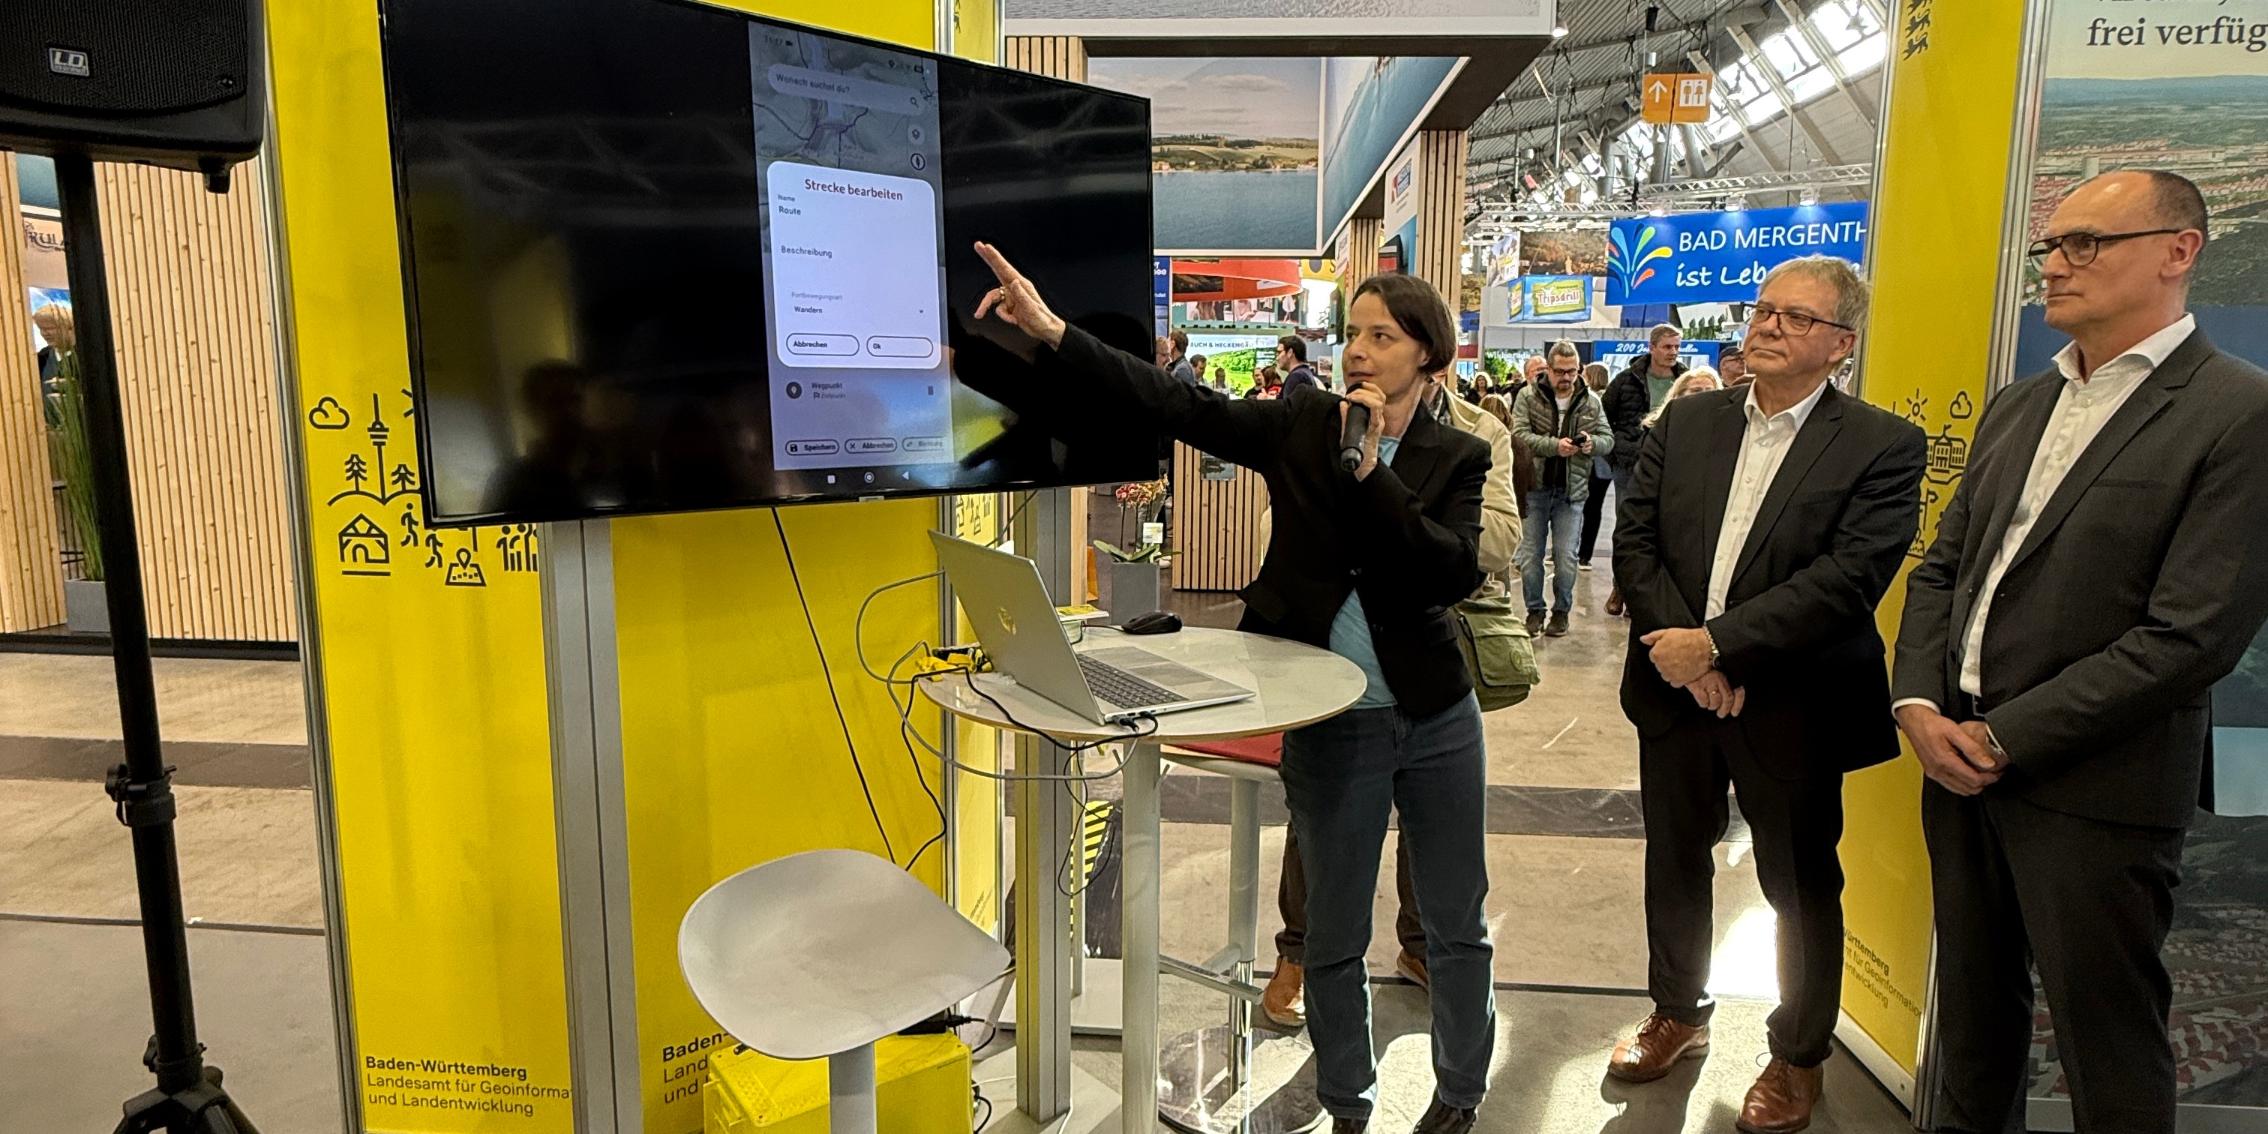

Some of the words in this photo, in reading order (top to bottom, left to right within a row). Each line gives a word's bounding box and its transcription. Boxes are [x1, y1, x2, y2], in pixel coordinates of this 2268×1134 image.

[2086, 17, 2146, 46] frei
[776, 72, 809, 87] Wonach
[809, 78, 835, 92] suchst
[777, 194, 796, 203] Name
[804, 178, 846, 195] Strecke
[847, 183, 903, 201] bearbeiten
[778, 205, 801, 216] Route
[1679, 230, 1727, 252] BAD
[781, 245, 833, 258] Beschreibung
[1676, 262, 1712, 287] ist
[1537, 289, 1580, 305] Tripsdrill
[794, 305, 823, 314] Wandern
[793, 340, 828, 349] Abbrechen
[1615, 343, 1636, 353] 200
[804, 443, 836, 452] Speichern
[862, 441, 894, 450] Abbrechen
[365, 1055, 527, 1081] Baden-Württemberg
[367, 1073, 451, 1092] Landesamt
[456, 1078, 476, 1093] für
[664, 1078, 698, 1104] und
[368, 1092, 398, 1106] und
[402, 1093, 533, 1118] Landentwicklung
